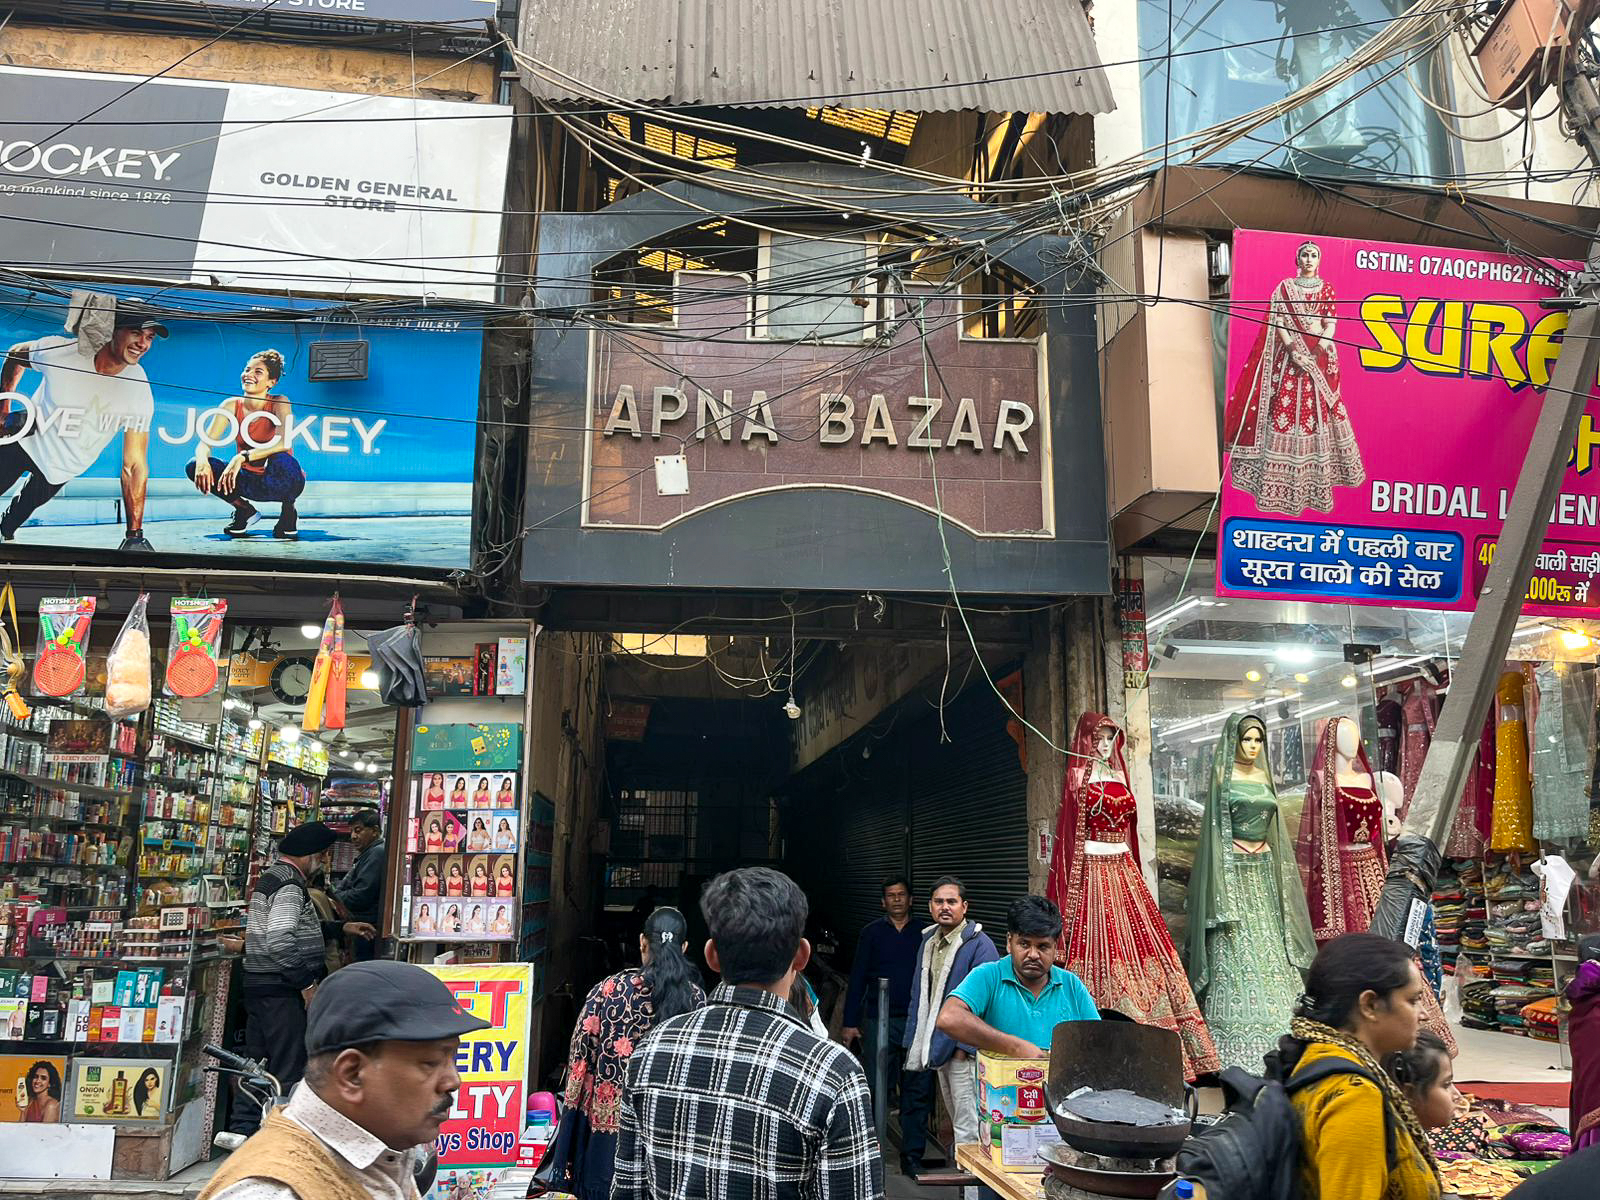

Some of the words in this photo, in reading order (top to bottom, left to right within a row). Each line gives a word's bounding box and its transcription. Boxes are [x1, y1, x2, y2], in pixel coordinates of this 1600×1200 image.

[0, 140, 182, 181] OCKEY
[20, 183, 86, 198] mankind
[89, 187, 129, 203] since
[135, 190, 172, 205] 1876
[259, 171, 350, 192] GOLDEN
[357, 180, 458, 202] GENERAL
[325, 194, 397, 213] STORE
[1356, 249, 1414, 273] GSTIN:
[1359, 293, 1569, 393] SURA
[100, 414, 147, 434] WITH
[157, 407, 388, 454] JOCKEY
[602, 383, 780, 444] APNA
[819, 393, 1036, 455] BAZAR
[1371, 480, 1488, 519] BRIDAL
[1232, 529, 1315, 553] शाहदरा
[1319, 528, 1345, 555] में
[1347, 533, 1410, 560] पहली
[1414, 541, 1455, 562] बार
[1240, 558, 1296, 587] सूरत
[1359, 562, 1393, 588] की
[1397, 563, 1444, 590] सेल
[43, 597, 80, 605] HOTSHOT
[174, 599, 210, 607] HOTSHOT
[1574, 581, 1591, 603] में
[454, 1040, 518, 1072] ERY
[447, 1085, 517, 1120] LTY
[467, 1127, 515, 1154] Shop
